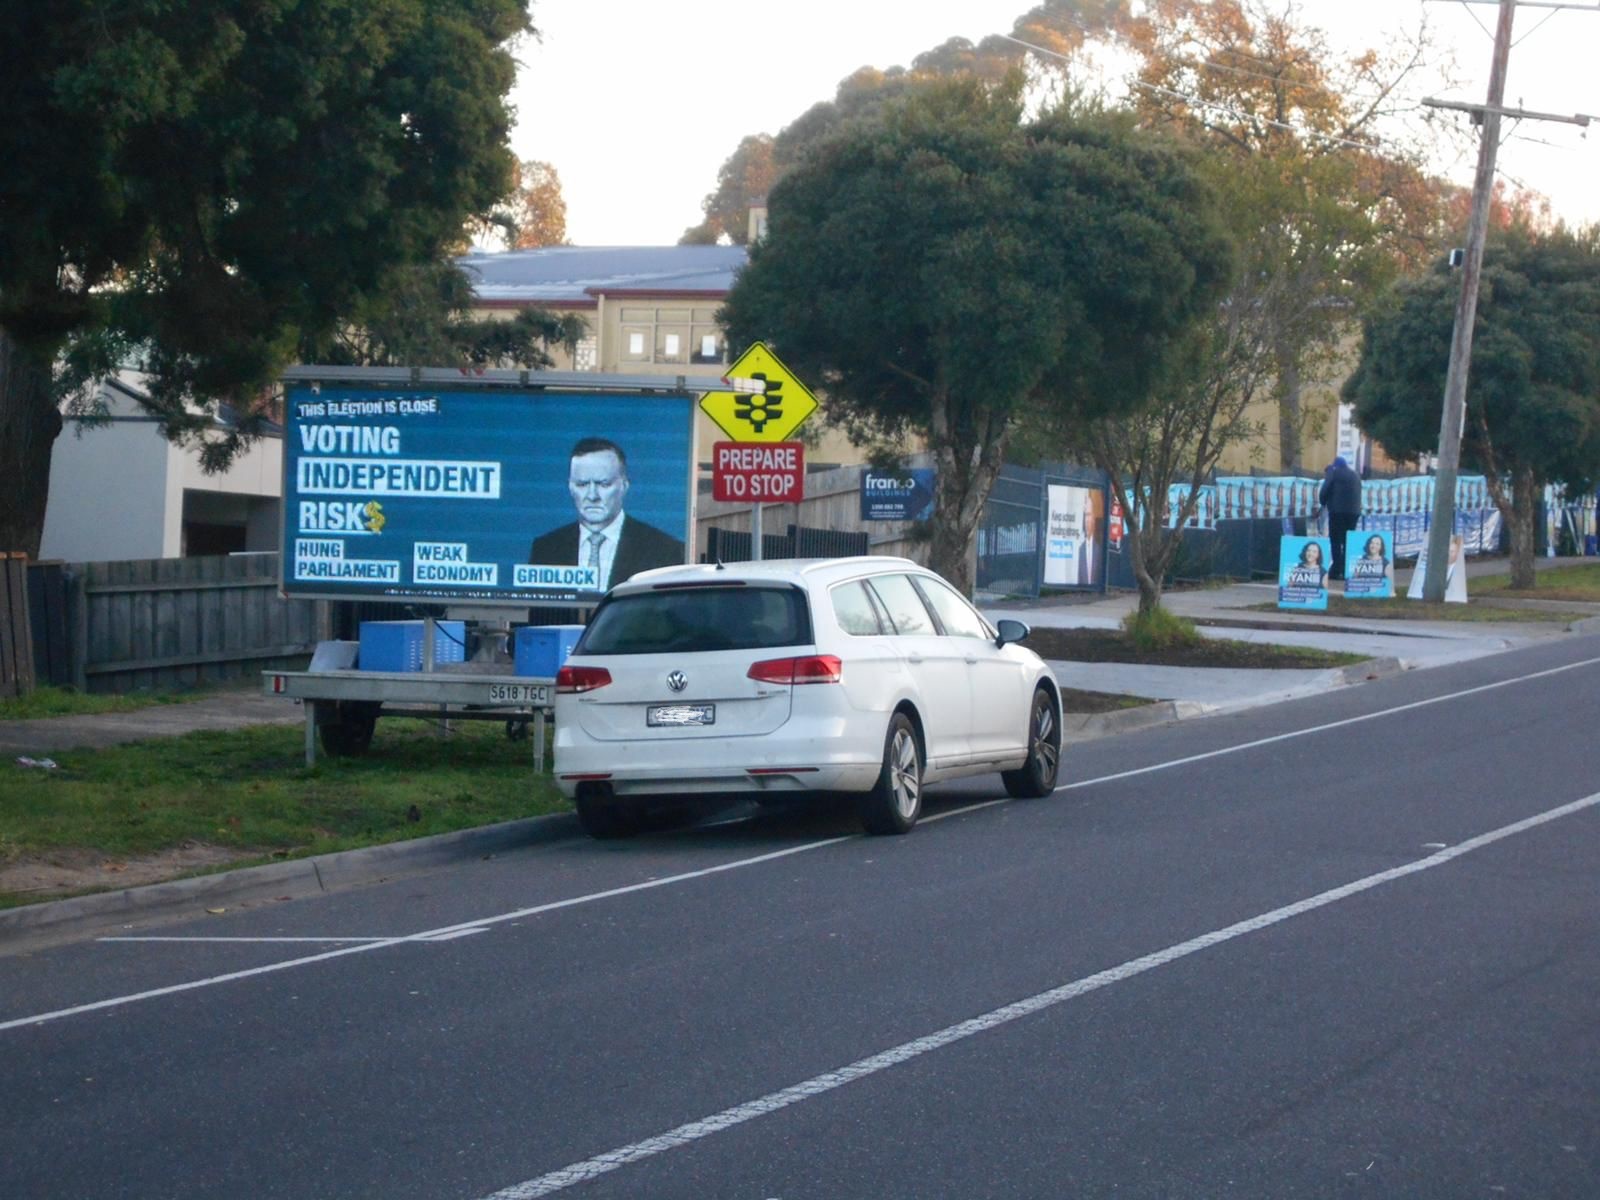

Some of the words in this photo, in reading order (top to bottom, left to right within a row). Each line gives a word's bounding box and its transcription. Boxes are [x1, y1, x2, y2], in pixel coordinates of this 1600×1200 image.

[299, 404, 325, 417] THIS
[328, 402, 383, 416] ELECTION
[384, 401, 396, 414] IS
[400, 399, 437, 414] CLOSE
[299, 424, 401, 455] VOTING
[719, 448, 797, 470] PREPARE
[303, 462, 495, 493] INDEPENDENT
[723, 474, 746, 496] TO
[750, 474, 795, 496] STOP
[298, 543, 341, 558] HUNG
[417, 545, 464, 561] WEAK
[298, 562, 397, 579] PARLIAMENT
[416, 564, 493, 582] ECONOMY
[517, 568, 594, 584] GRIDLOCK
[491, 685, 518, 699] S618
[523, 686, 545, 700] TGC
